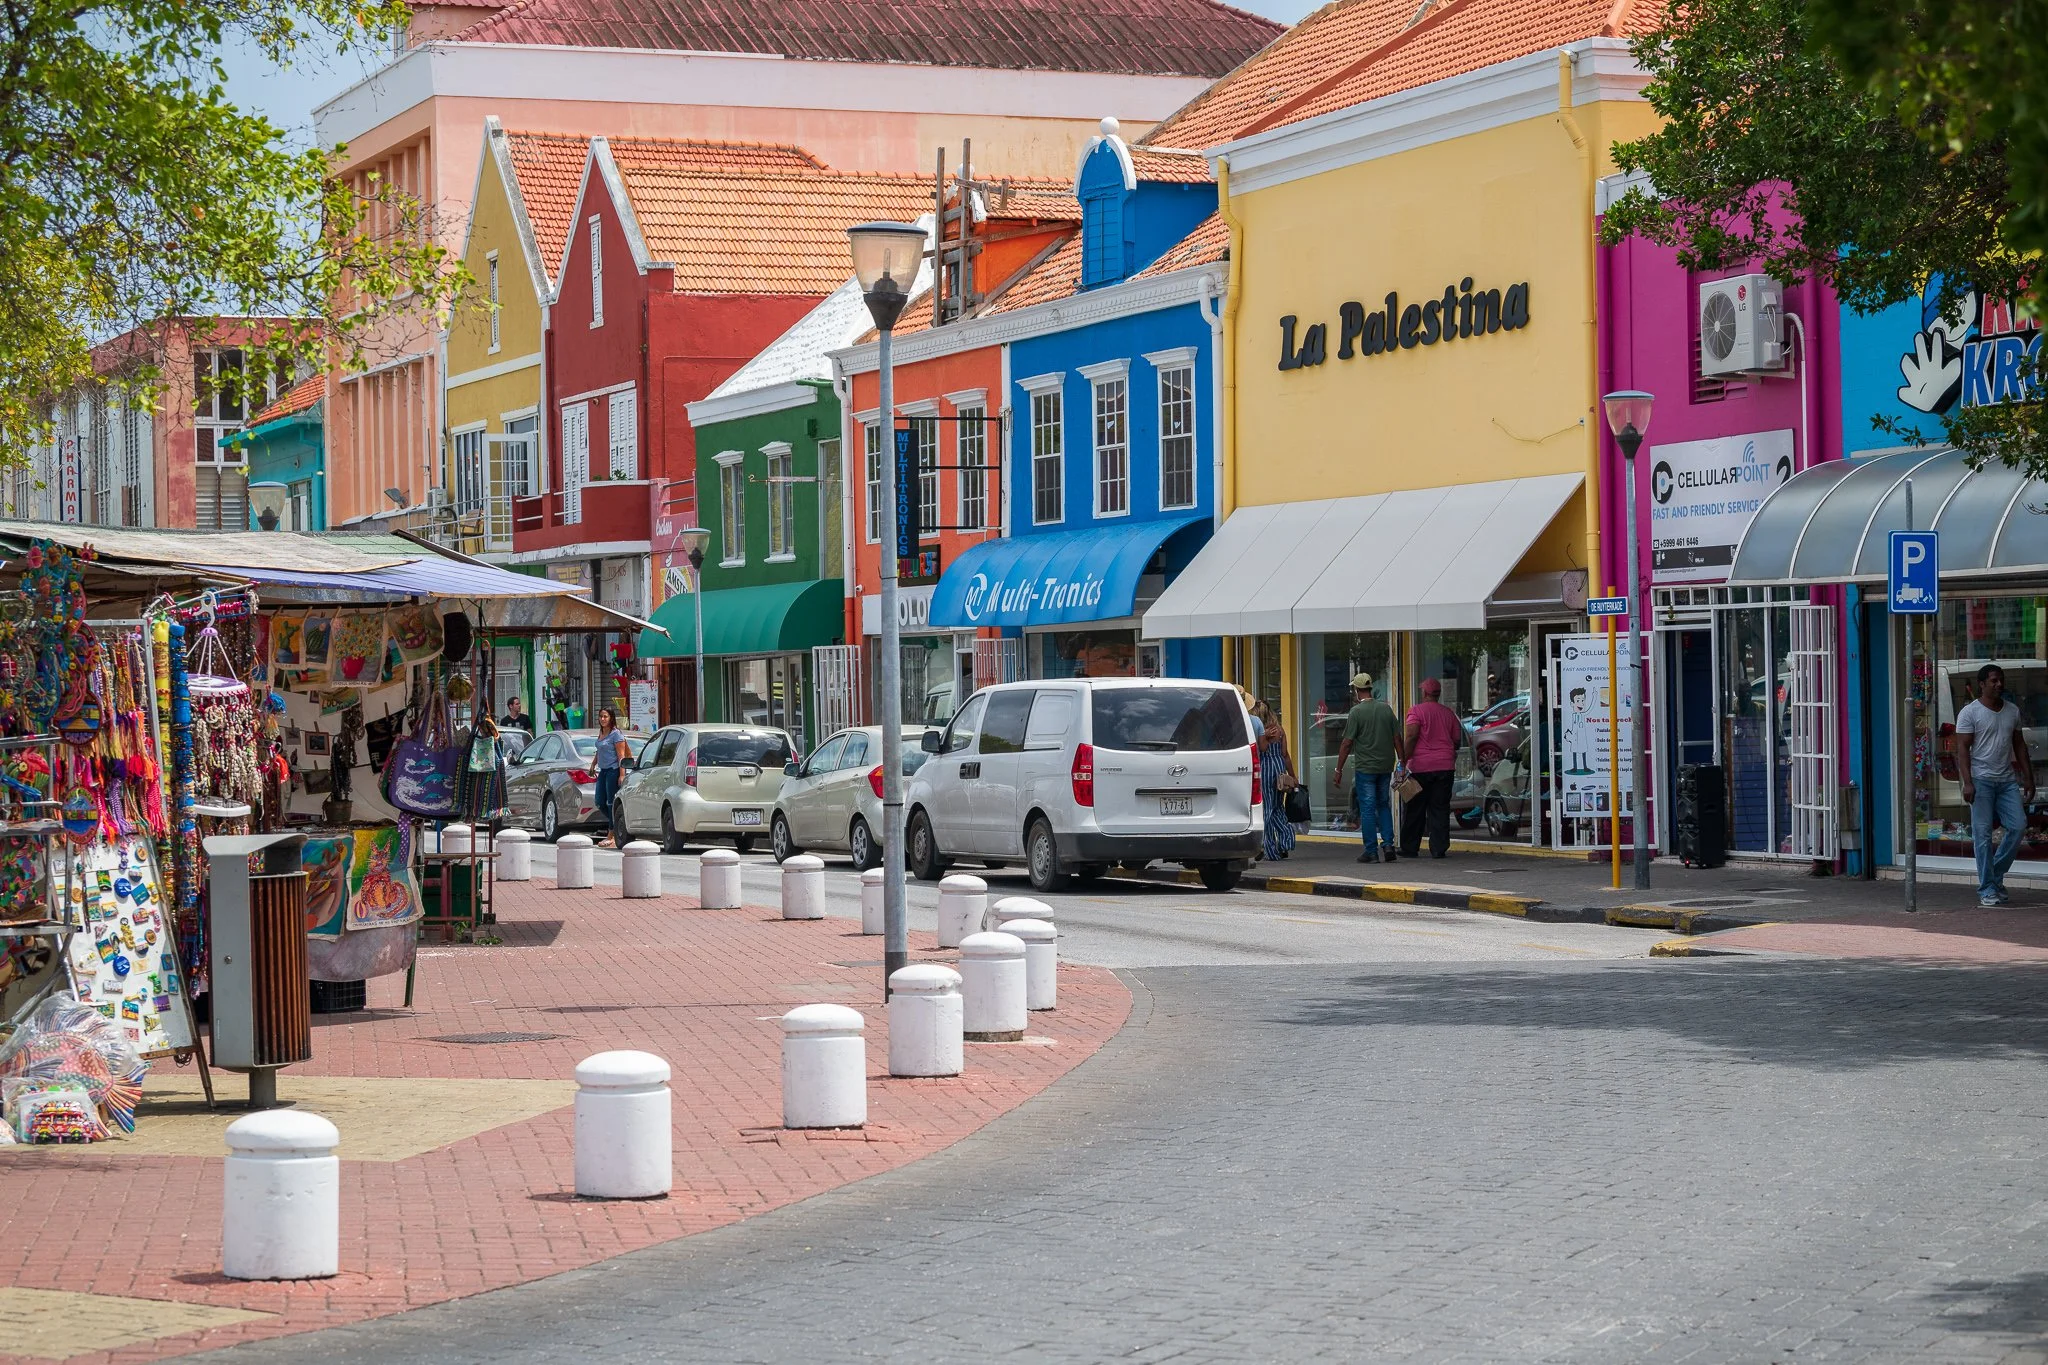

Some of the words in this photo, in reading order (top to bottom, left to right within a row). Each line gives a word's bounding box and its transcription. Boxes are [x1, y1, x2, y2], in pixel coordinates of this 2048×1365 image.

[1738, 303, 1747, 312] LG
[1278, 314, 1328, 371] La
[1337, 276, 1531, 360] Palestina
[897, 432, 910, 555] MULTITRONICS
[1652, 507, 1670, 521] FAST
[1671, 505, 1689, 519] AND
[1690, 502, 1726, 517] FRIENDLY
[1727, 499, 1759, 514] SERVICE
[1659, 538, 1675, 548] +5999
[1676, 537, 1685, 547] 461
[1902, 541, 1926, 578] P
[985, 572, 1104, 613] Multi-Tronics
[1591, 603, 1597, 612] DE
[898, 596, 930, 627] OLO
